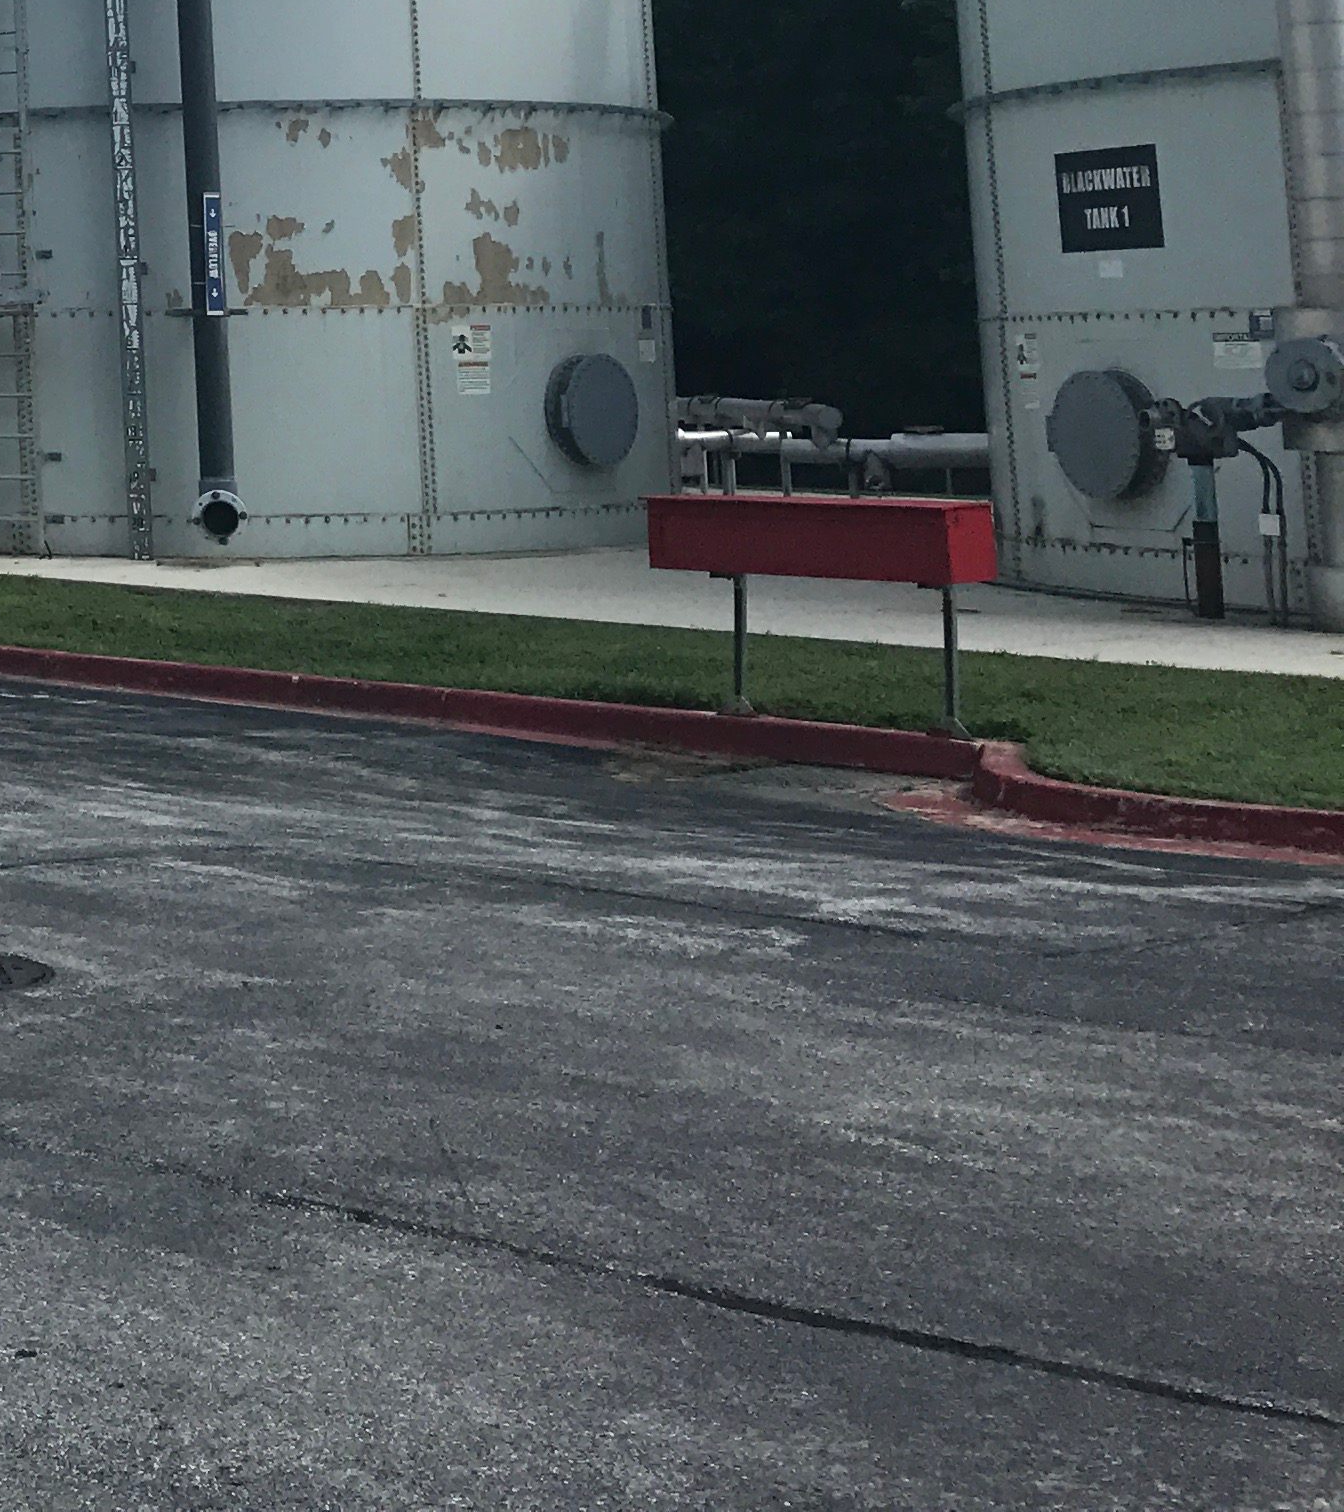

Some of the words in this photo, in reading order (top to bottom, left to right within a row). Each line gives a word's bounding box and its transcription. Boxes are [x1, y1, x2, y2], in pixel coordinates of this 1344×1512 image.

[1061, 166, 1151, 194] BLACKWATER
[1084, 207, 1119, 229] TANK
[1121, 205, 1129, 227] 1
[207, 230, 220, 279] OVERFLOW
